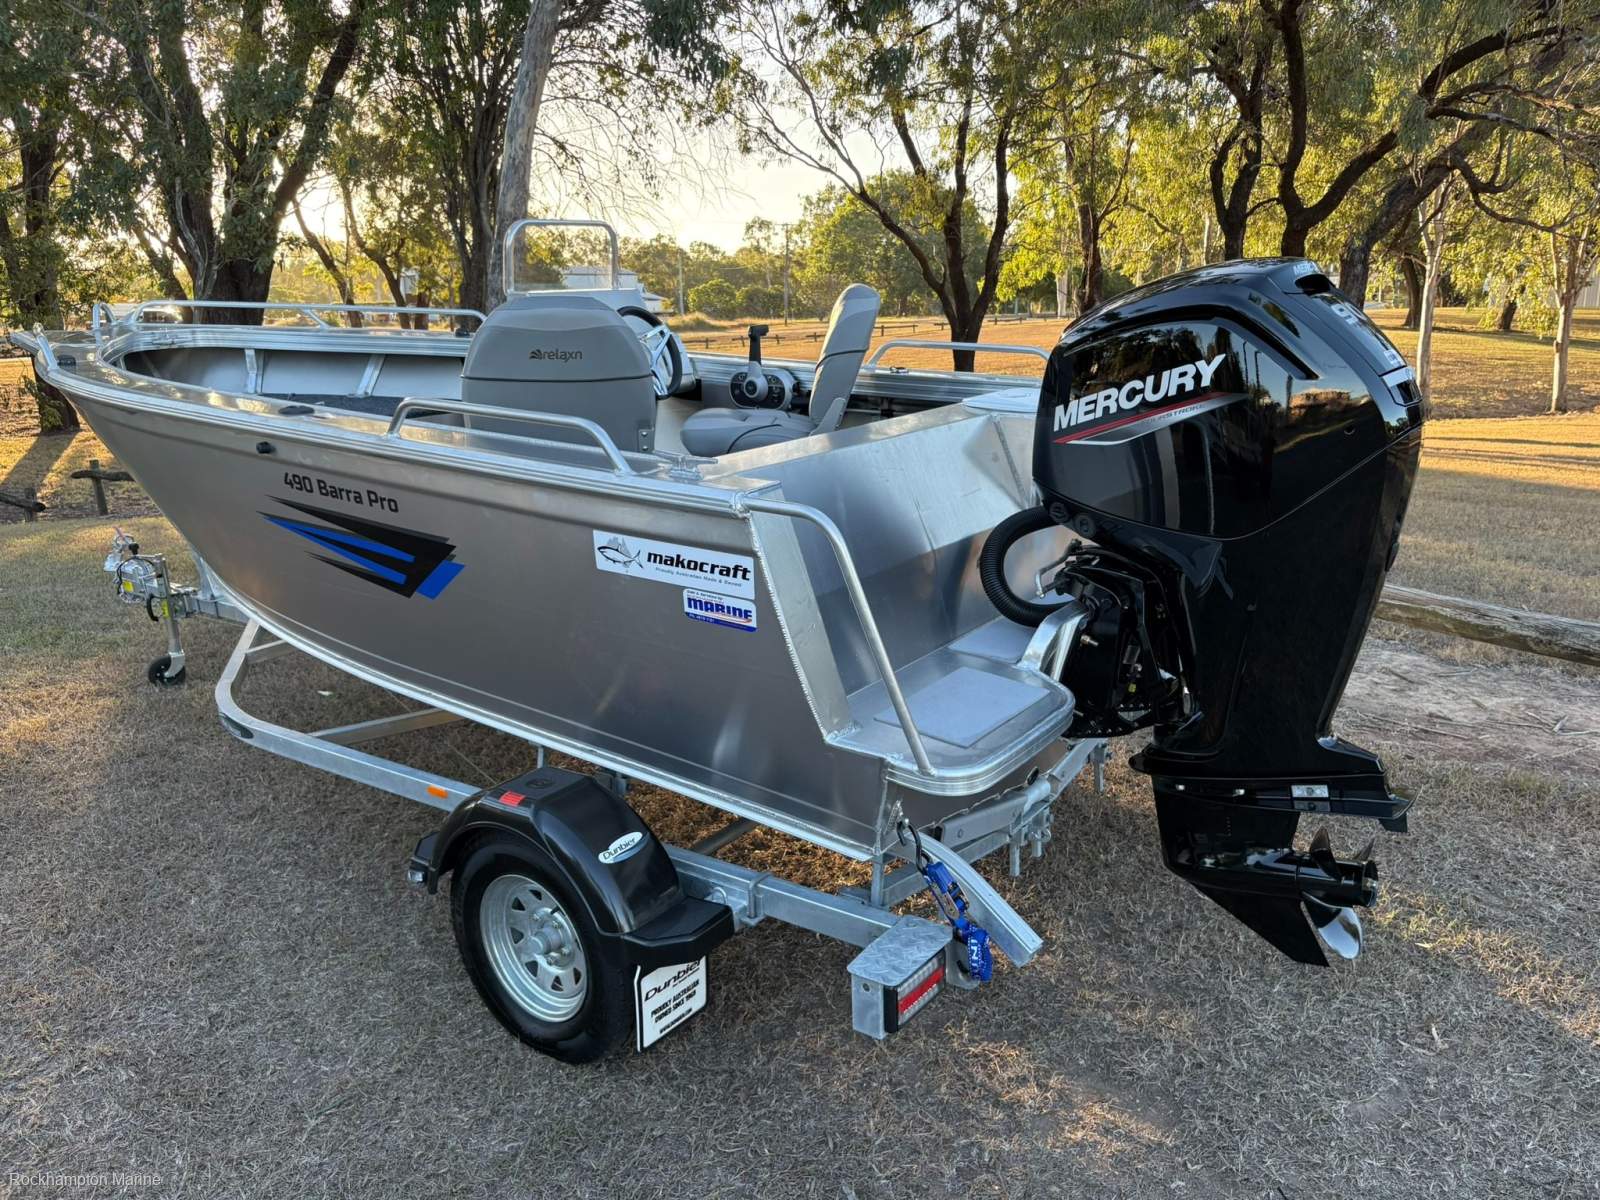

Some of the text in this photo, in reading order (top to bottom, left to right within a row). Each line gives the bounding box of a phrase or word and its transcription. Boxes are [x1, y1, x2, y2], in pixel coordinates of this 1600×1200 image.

[542, 349, 583, 363] relaxn
[1053, 353, 1227, 432] MERCURY
[284, 472, 399, 513] 490 Barra Pro
[647, 552, 751, 581] makocraft
[602, 837, 636, 860] Dunbier
[644, 960, 700, 1002] Dunbier
